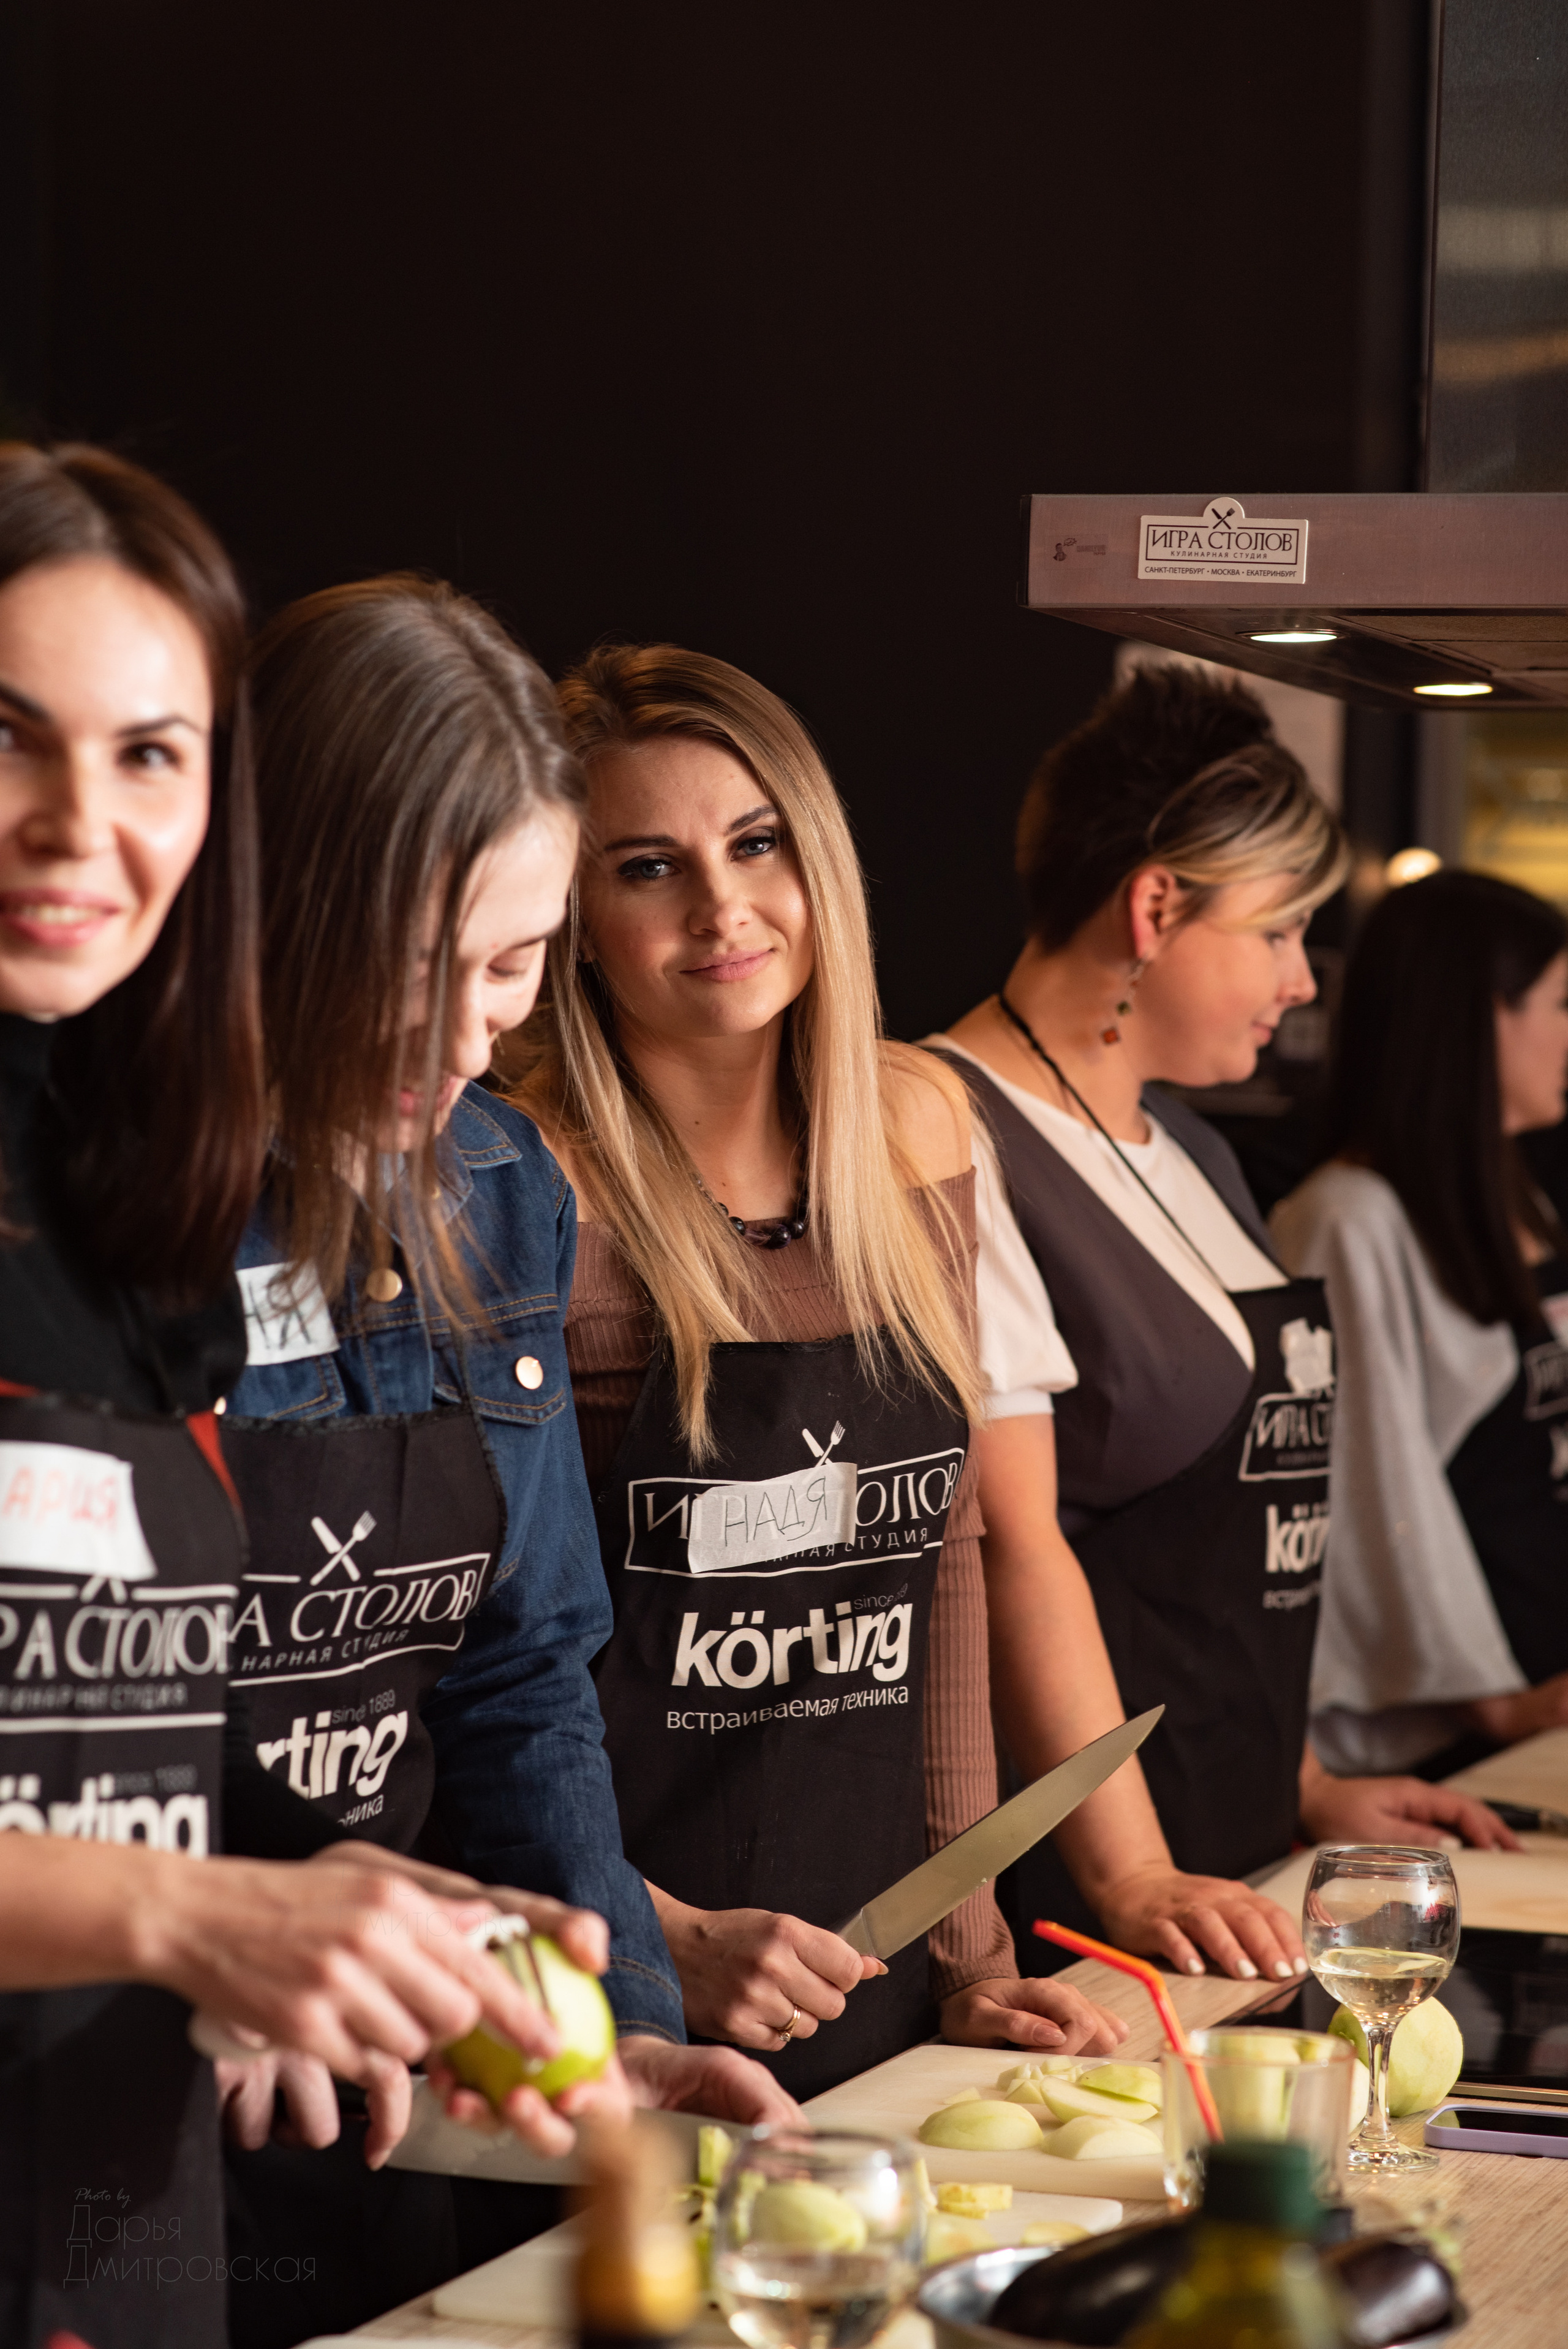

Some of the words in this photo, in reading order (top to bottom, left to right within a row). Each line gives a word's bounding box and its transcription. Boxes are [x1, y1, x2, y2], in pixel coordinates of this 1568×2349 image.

[1152, 529, 1203, 548] ИГРА
[1208, 531, 1292, 551] СТОЛОВ
[1144, 566, 1205, 575] САНКТ-ПЕТЕРБУРГ
[1, 1465, 118, 1533] АРИЯ
[724, 1475, 827, 1547] НАДЯ
[290, 1569, 477, 1642] СТОЛОВ
[241, 1646, 333, 1672] НАРНАЯ
[671, 1601, 913, 1689] körting
[666, 1695, 838, 1735] встраиваемая
[842, 1686, 909, 1714] техника
[257, 1711, 409, 1799] rting
[337, 1794, 385, 1827] ника
